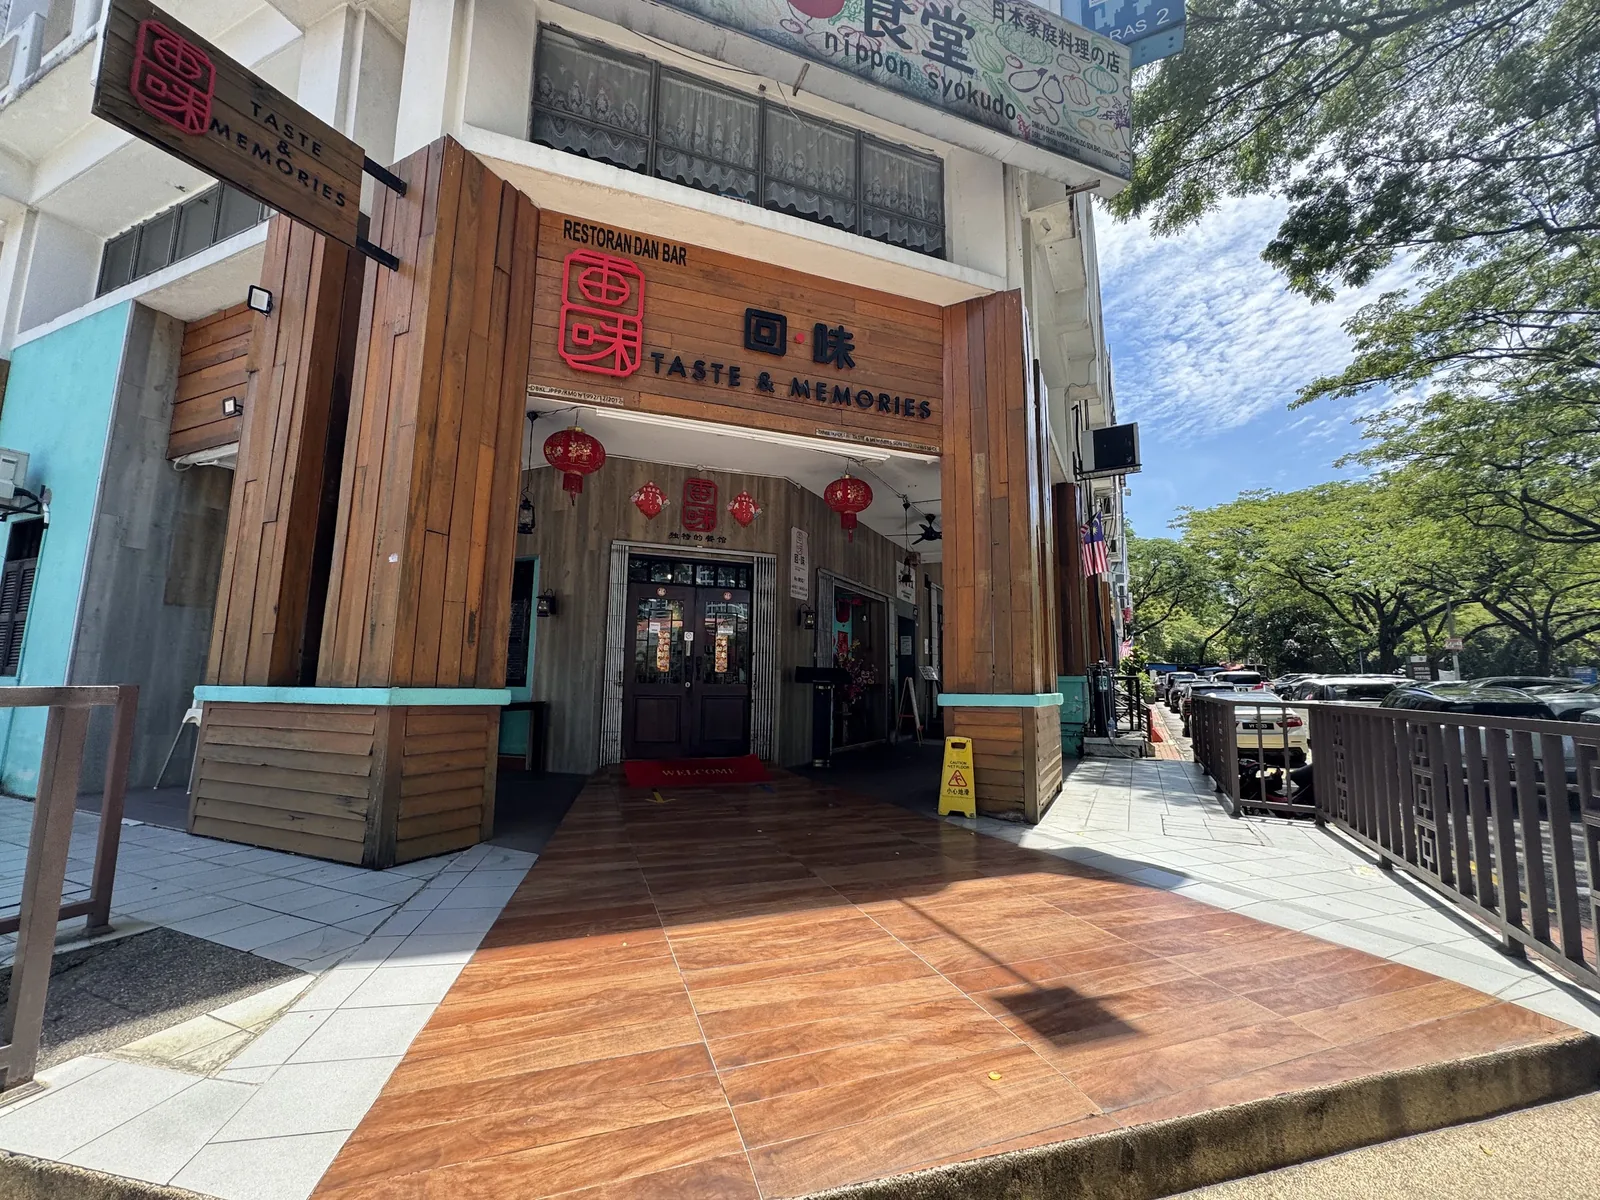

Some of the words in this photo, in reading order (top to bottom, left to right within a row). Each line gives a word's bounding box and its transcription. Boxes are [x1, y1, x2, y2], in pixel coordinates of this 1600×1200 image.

[1156, 8, 1170, 26] 2
[826, 31, 912, 80] nippon
[928, 71, 1016, 121] syokudo
[250, 101, 322, 158] TASTE
[277, 139, 292, 159] &
[209, 118, 346, 208] MEMORIES
[563, 219, 631, 254] RESTORAN
[634, 236, 659, 260] DAN
[662, 243, 687, 267] BAR
[651, 352, 741, 387] TASTE
[757, 371, 775, 393] &
[790, 377, 931, 419] MEMORIES
[662, 768, 739, 776] WELCOME
